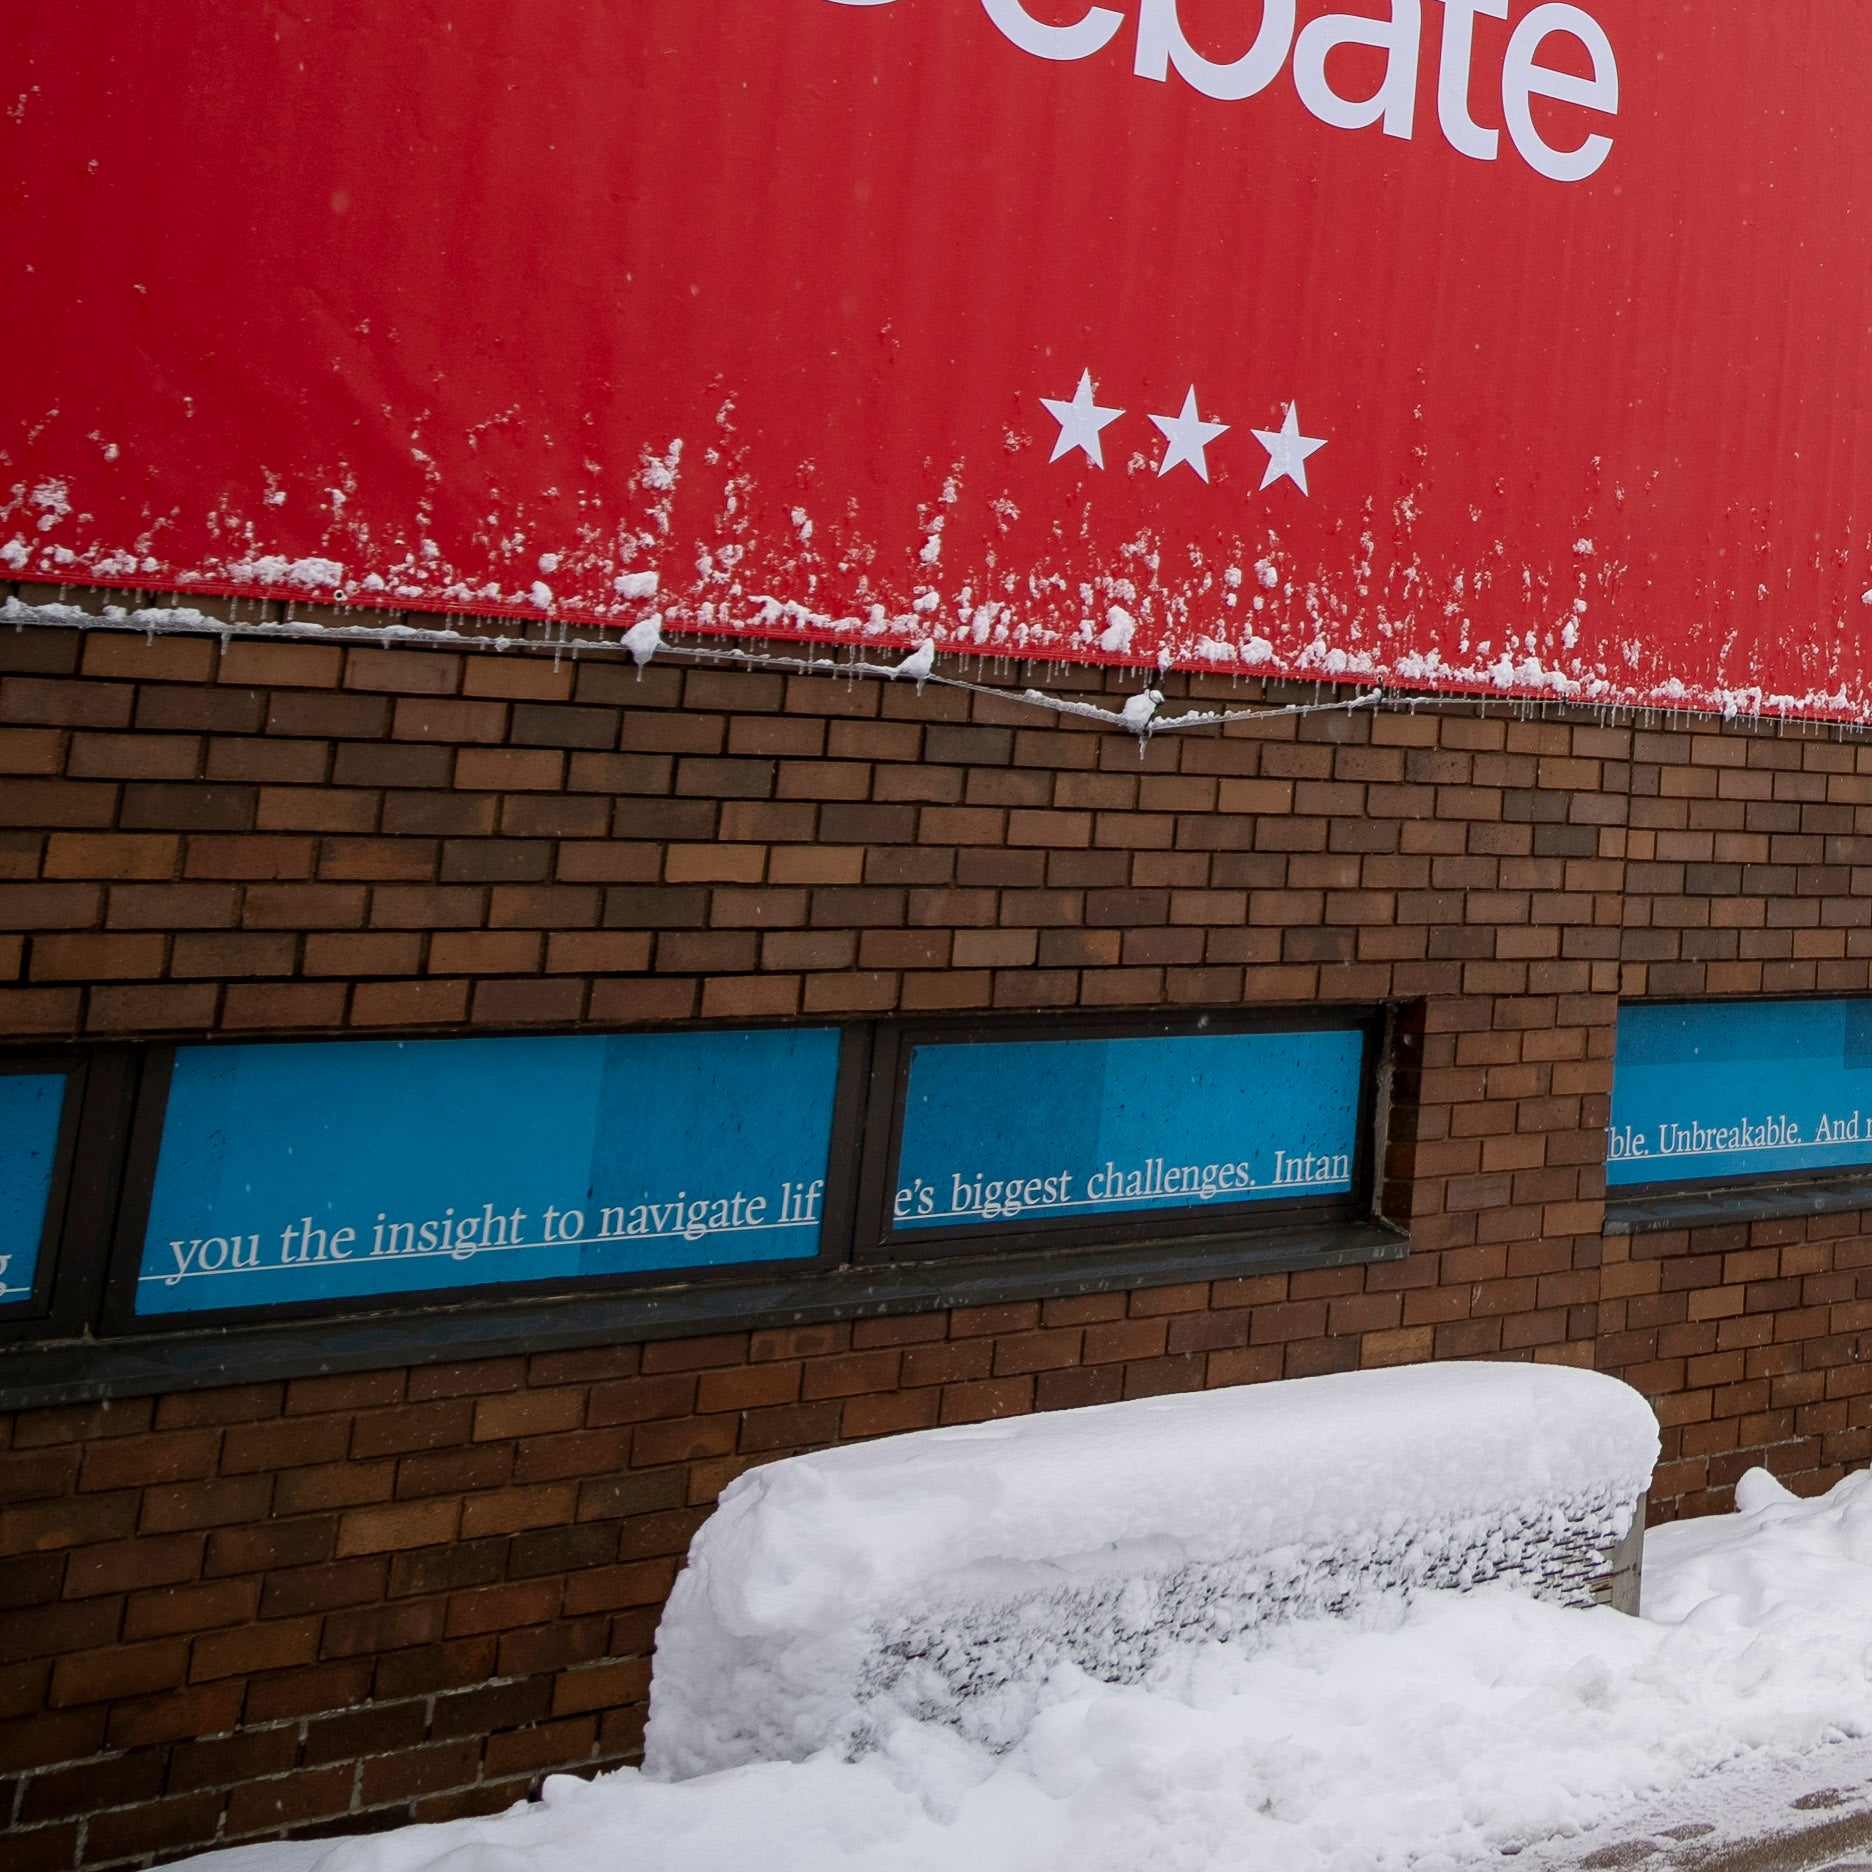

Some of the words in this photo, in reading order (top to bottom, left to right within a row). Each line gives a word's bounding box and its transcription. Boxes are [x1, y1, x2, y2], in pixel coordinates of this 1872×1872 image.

[1659, 1115, 1801, 1154] Unbreakable.
[1814, 1111, 1860, 1142] And
[952, 1171, 1072, 1219] biggest
[1087, 1155, 1256, 1201] challenges.
[1272, 1150, 1349, 1185] Intan
[169, 1232, 260, 1285] you
[280, 1216, 354, 1264] the
[371, 1203, 526, 1261] insight
[543, 1204, 585, 1242] to
[600, 1188, 767, 1239] navigate
